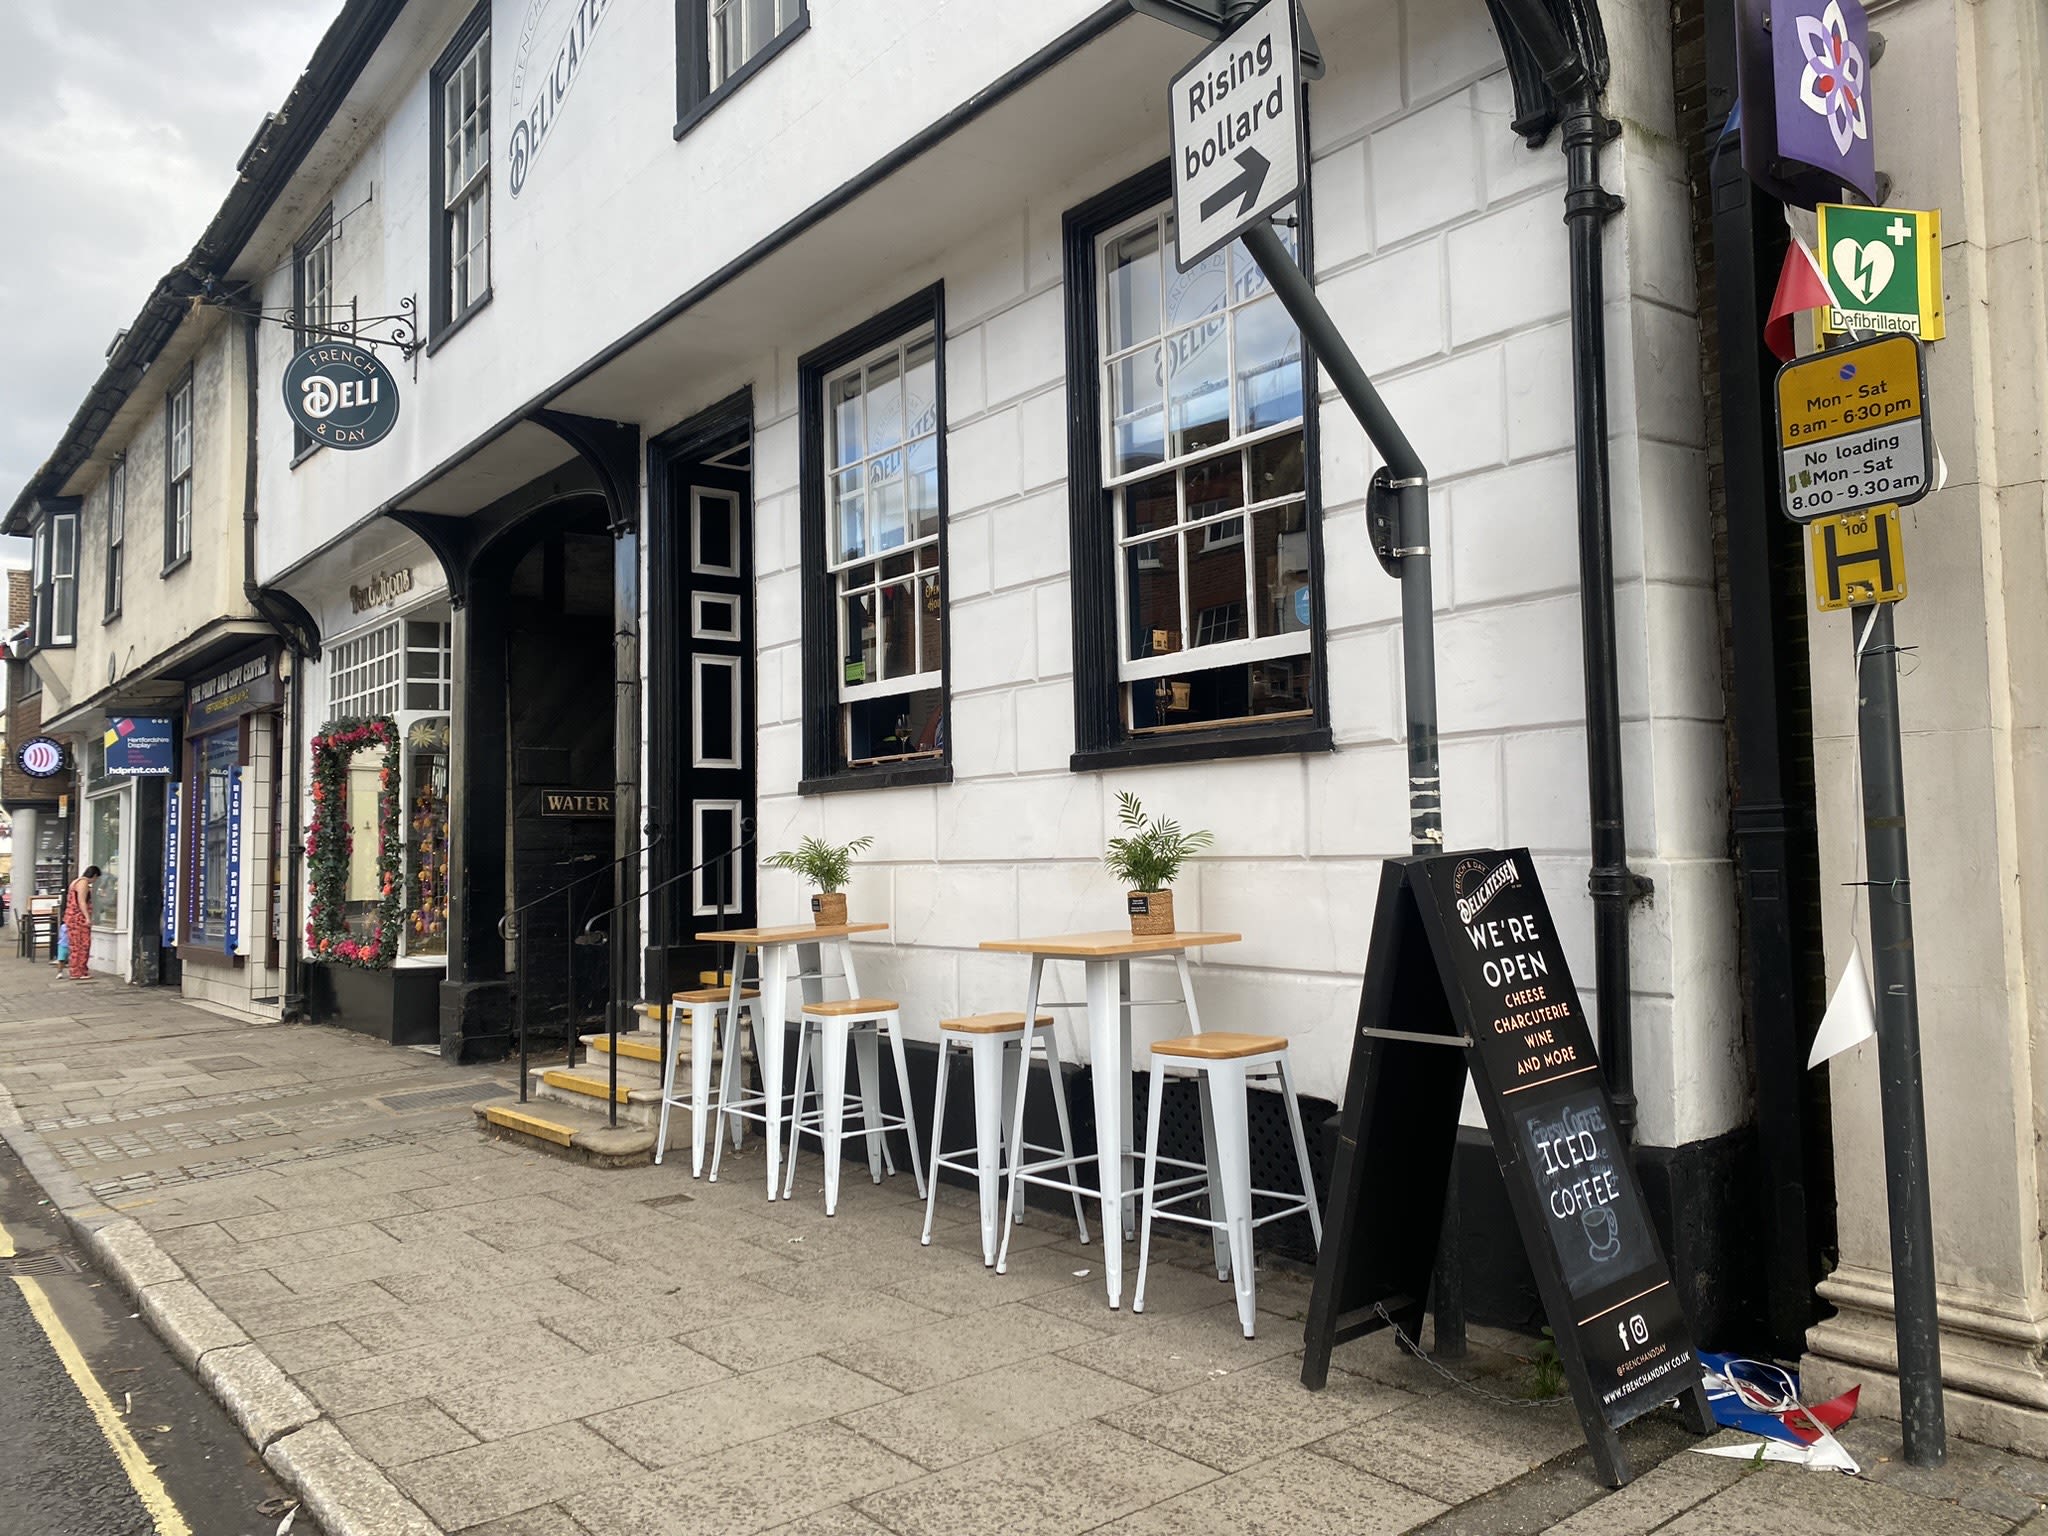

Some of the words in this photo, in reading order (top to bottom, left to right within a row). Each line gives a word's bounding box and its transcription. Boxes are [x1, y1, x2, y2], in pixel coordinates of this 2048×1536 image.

[1189, 33, 1273, 123] Rising
[1185, 75, 1283, 181] bollard
[1832, 310, 1918, 332] Defibrillator
[309, 349, 376, 375] FRENCH
[301, 375, 379, 419] DELI
[1807, 393, 1841, 412] Mon
[1858, 380, 1888, 399] Sat
[317, 423, 326, 435] &
[336, 428, 365, 442] DAY
[1803, 418, 1827, 434] am
[1884, 398, 1912, 416] pm
[1805, 451, 1827, 467] No
[1836, 436, 1900, 460] loading
[1813, 468, 1849, 486] Mon
[1863, 456, 1894, 474] Sat
[1792, 490, 1834, 511] 8.00
[1847, 478, 1889, 499] 9.30
[1892, 474, 1919, 488] am
[1844, 522, 1868, 536] 100
[1824, 514, 1893, 600] H
[202, 678, 217, 700] PRINT
[217, 672, 228, 694] AND
[229, 665, 243, 689] COPY
[243, 655, 267, 683] CENTRE
[109, 766, 170, 775] hdprint.co.uk
[232, 785, 240, 816] HIGH
[548, 795, 609, 811] WATER
[231, 824, 239, 863] SPEED
[1455, 863, 1467, 895] FRENCH
[1456, 858, 1520, 925] DELICATESSEN
[167, 875, 176, 930] PRINTING
[229, 872, 238, 936] PRINTING
[1465, 914, 1540, 952] WE'RE
[1483, 951, 1549, 988] OPEN
[1504, 986, 1547, 1008] CHEESE
[1494, 1002, 1570, 1034] CHARCUTERIE
[1524, 1029, 1554, 1048] WINE
[1517, 1056, 1540, 1076] AND
[1543, 1046, 1576, 1068] MORE
[1537, 1130, 1597, 1175] ICED
[1550, 1170, 1620, 1219] COFFEE
[1616, 1343, 1667, 1377] @FRENCHANDDAY
